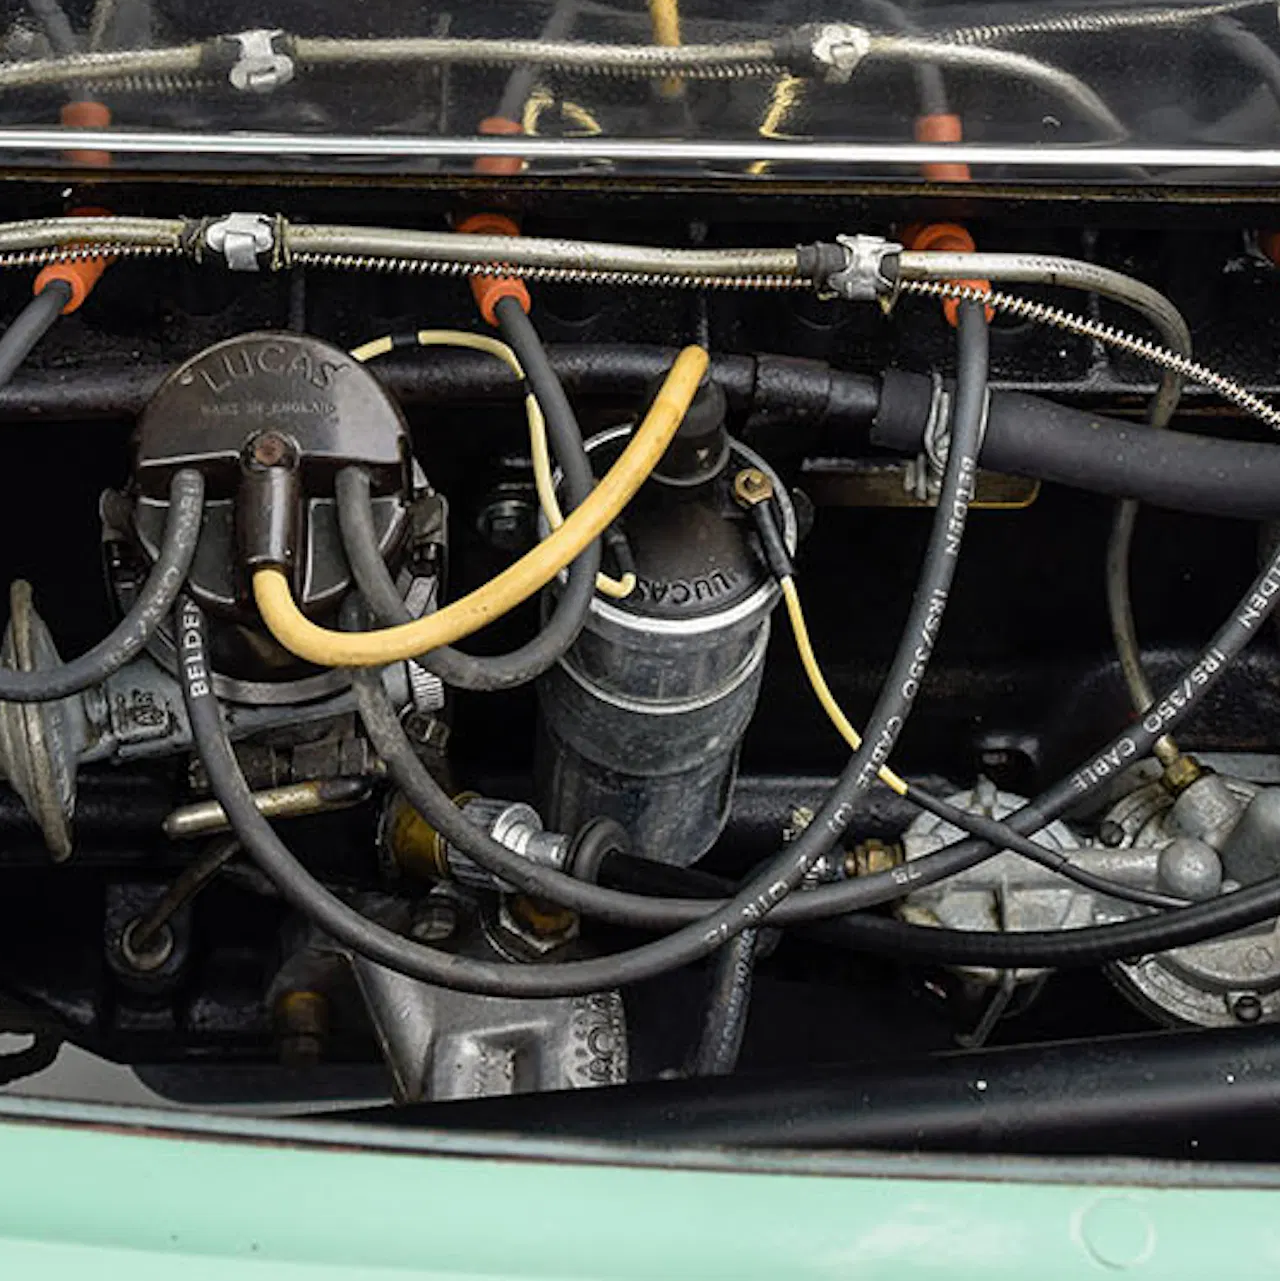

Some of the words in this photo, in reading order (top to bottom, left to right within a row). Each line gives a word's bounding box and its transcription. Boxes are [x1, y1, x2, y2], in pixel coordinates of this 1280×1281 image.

[198, 344, 350, 393] LUCAS
[944, 456, 974, 557] BELDEN
[182, 594, 210, 698] BELDEN
[1142, 646, 1228, 734] IRS/350
[1070, 737, 1137, 793] CABLE
